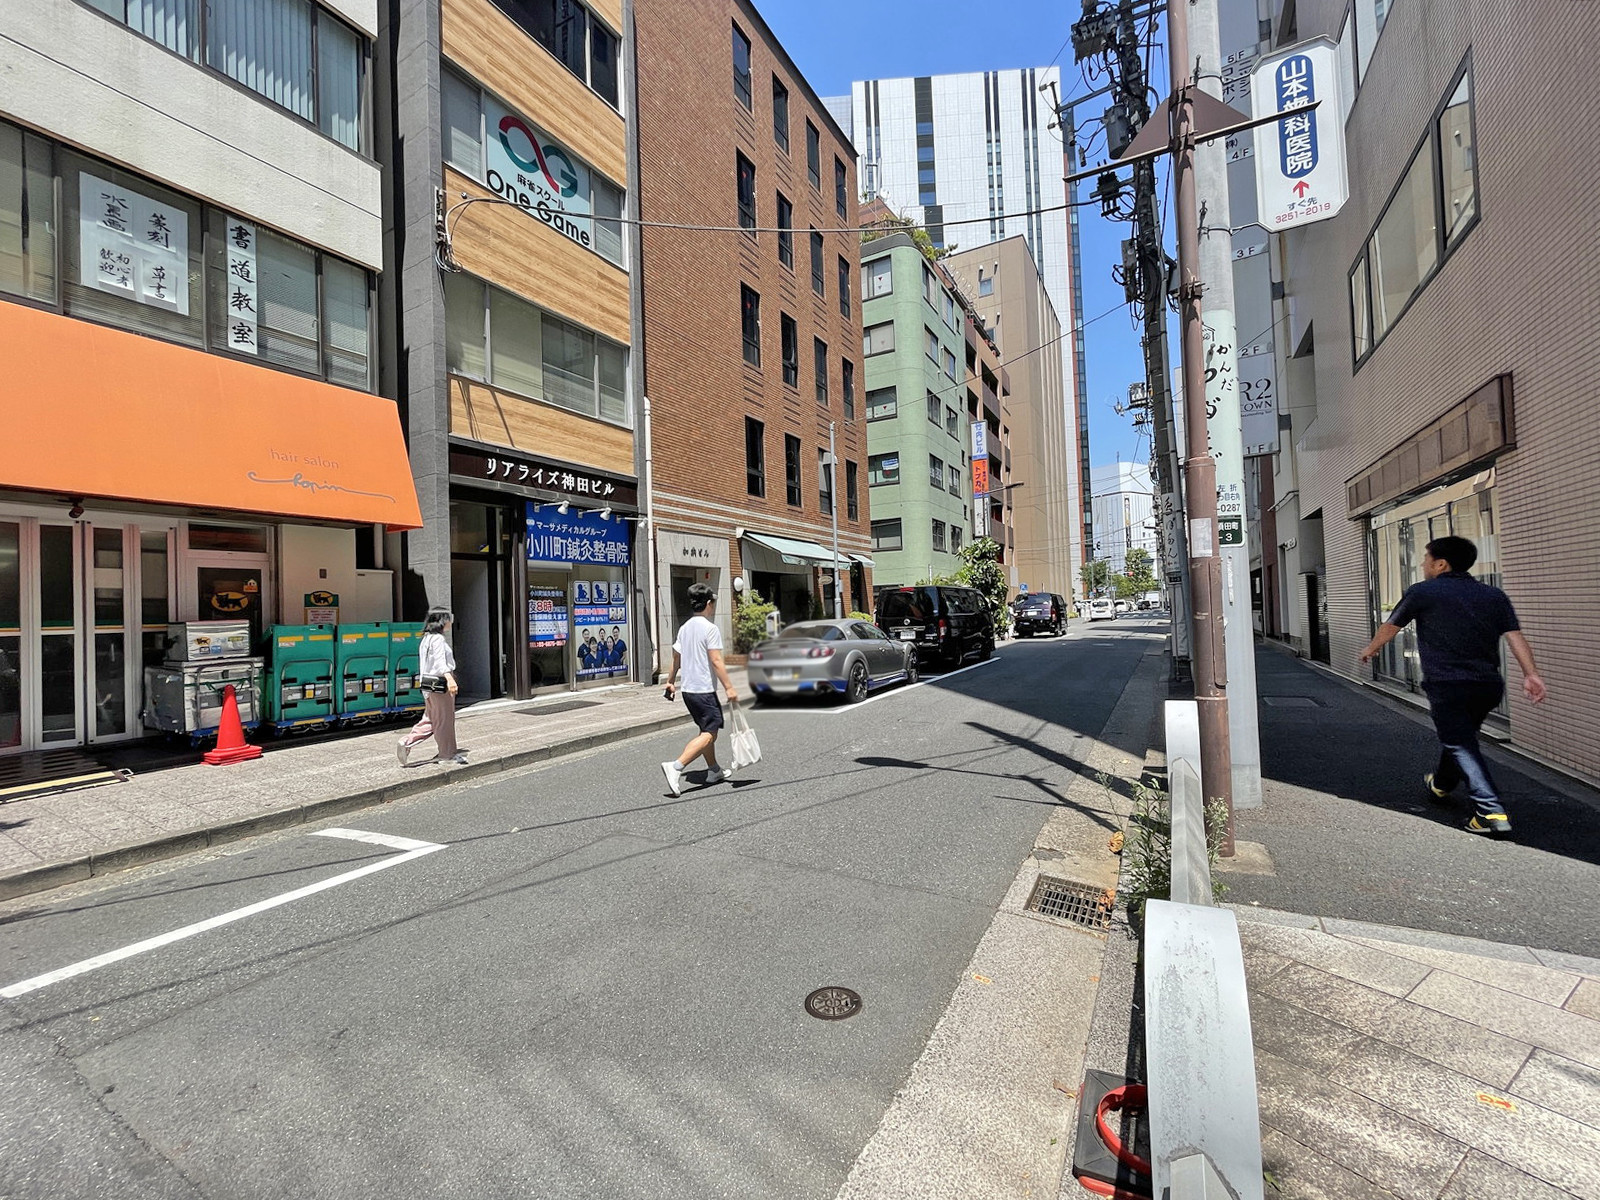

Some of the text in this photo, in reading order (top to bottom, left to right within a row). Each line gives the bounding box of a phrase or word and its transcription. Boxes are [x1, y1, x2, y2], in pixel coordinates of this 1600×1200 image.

[1228, 50, 1245, 63] 5F
[1232, 149, 1249, 160] 4F
[517, 173, 566, 211] 麻雀スクール
[101, 193, 129, 232] 水墨画
[487, 169, 590, 246] One Game
[1275, 202, 1331, 224] 3251-2019
[1287, 197, 1318, 211] すぐ先
[1237, 246, 1255, 258] 3F
[150, 266, 166, 299] 草書
[230, 226, 256, 346] 書道教室
[1242, 346, 1260, 357] 2F
[1217, 343, 1232, 391] かんだ
[1240, 378, 1272, 401] R2
[270, 448, 339, 469] hair salon
[1246, 444, 1264, 454] 1F
[486, 458, 614, 495] リアライズ神田ビル
[536, 521, 607, 537] マーサメディカルグループ
[527, 533, 629, 564] 小川町鍼灸整骨院
